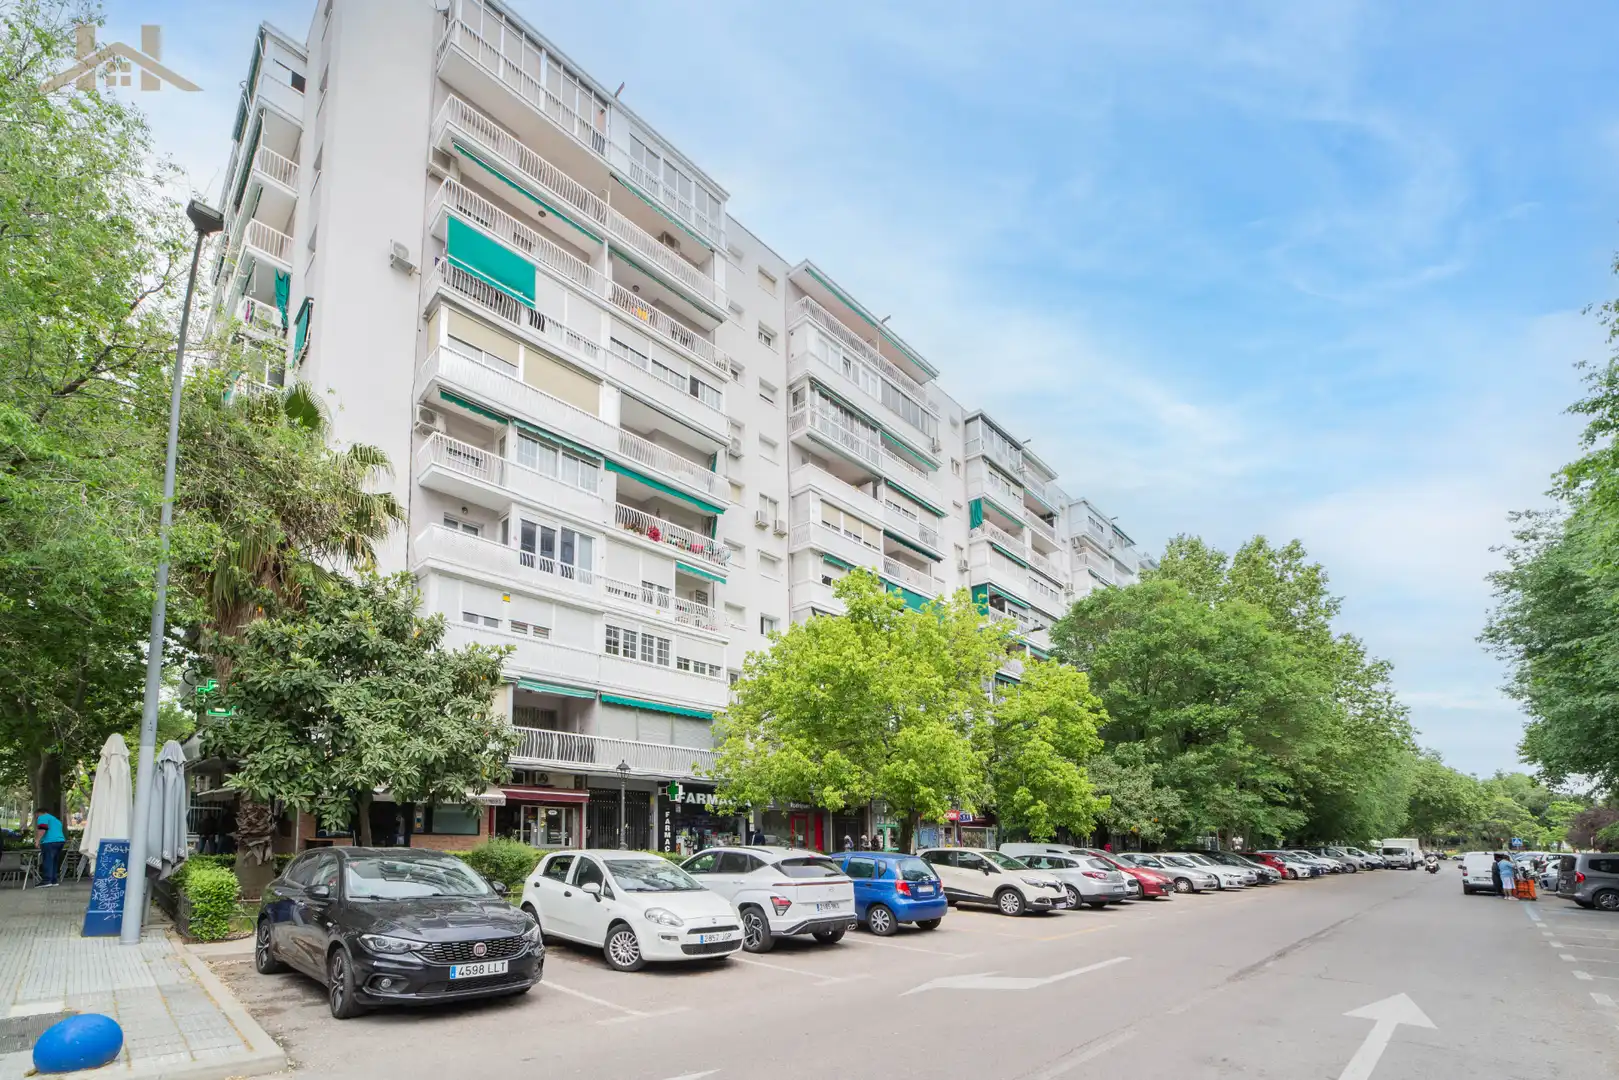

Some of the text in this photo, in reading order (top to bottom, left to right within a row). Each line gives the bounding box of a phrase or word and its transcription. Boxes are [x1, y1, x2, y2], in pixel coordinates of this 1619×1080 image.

[677, 792, 752, 808] FARMACA
[458, 962, 506, 977] 4598 LLT
